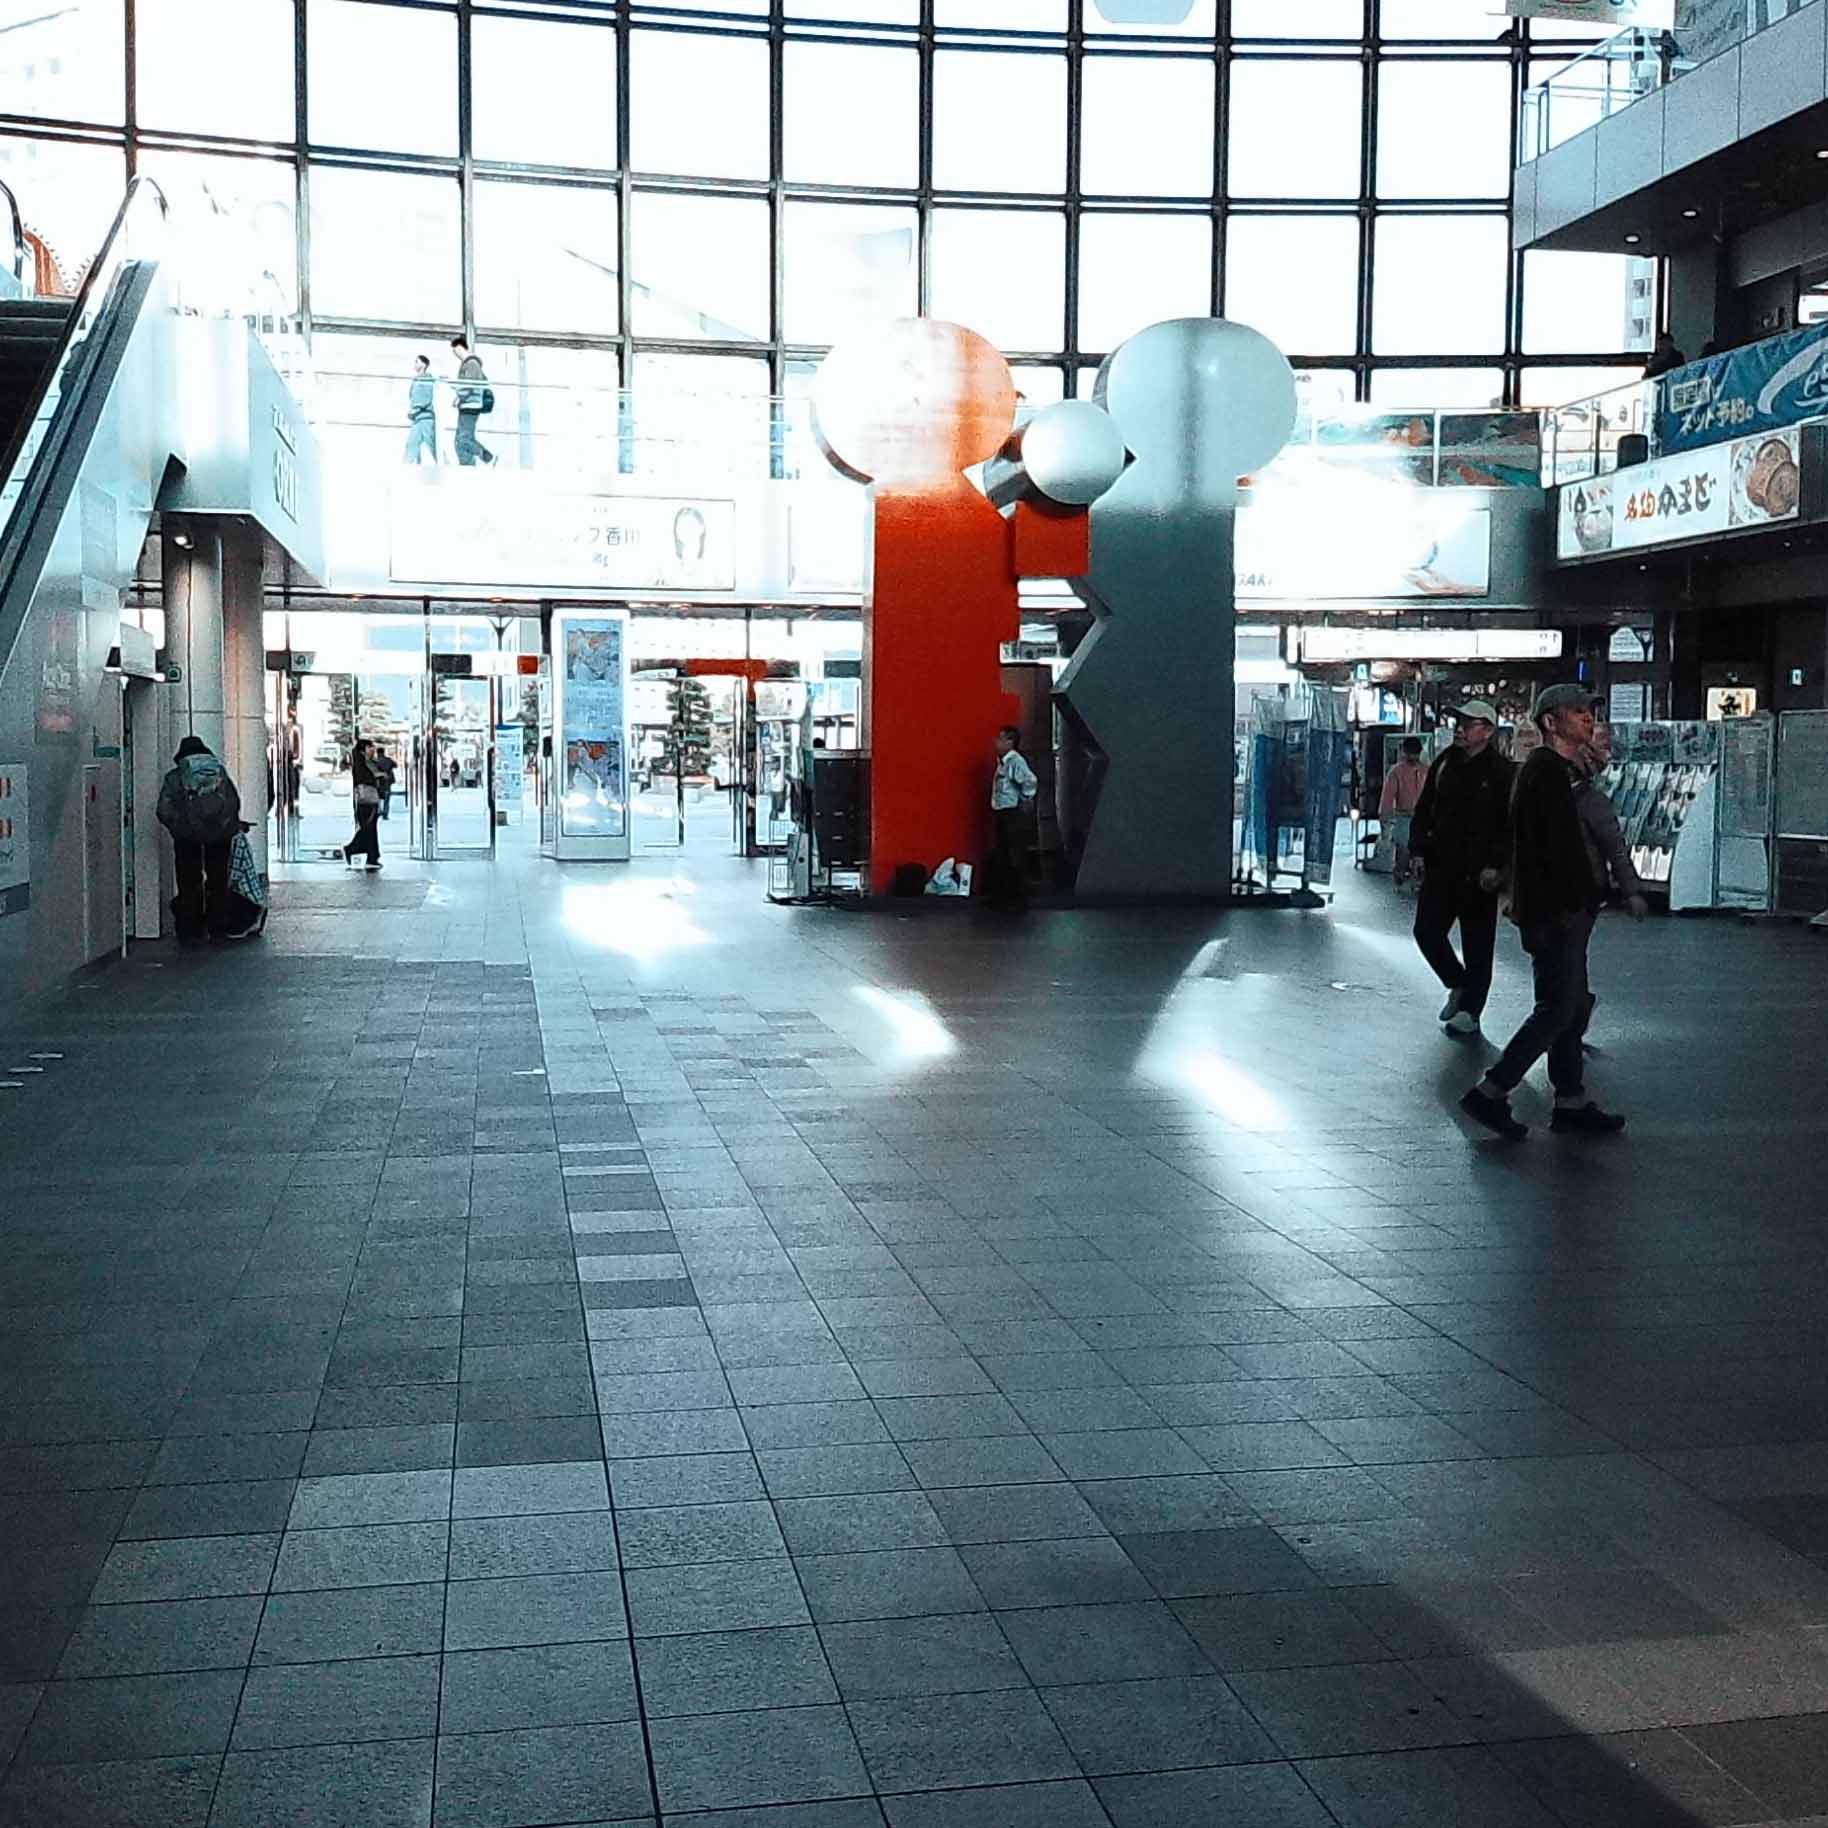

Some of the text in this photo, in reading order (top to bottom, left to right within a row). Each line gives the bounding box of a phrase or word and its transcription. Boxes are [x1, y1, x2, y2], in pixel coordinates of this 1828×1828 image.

[1625, 473, 1716, 521] 名物かまど
